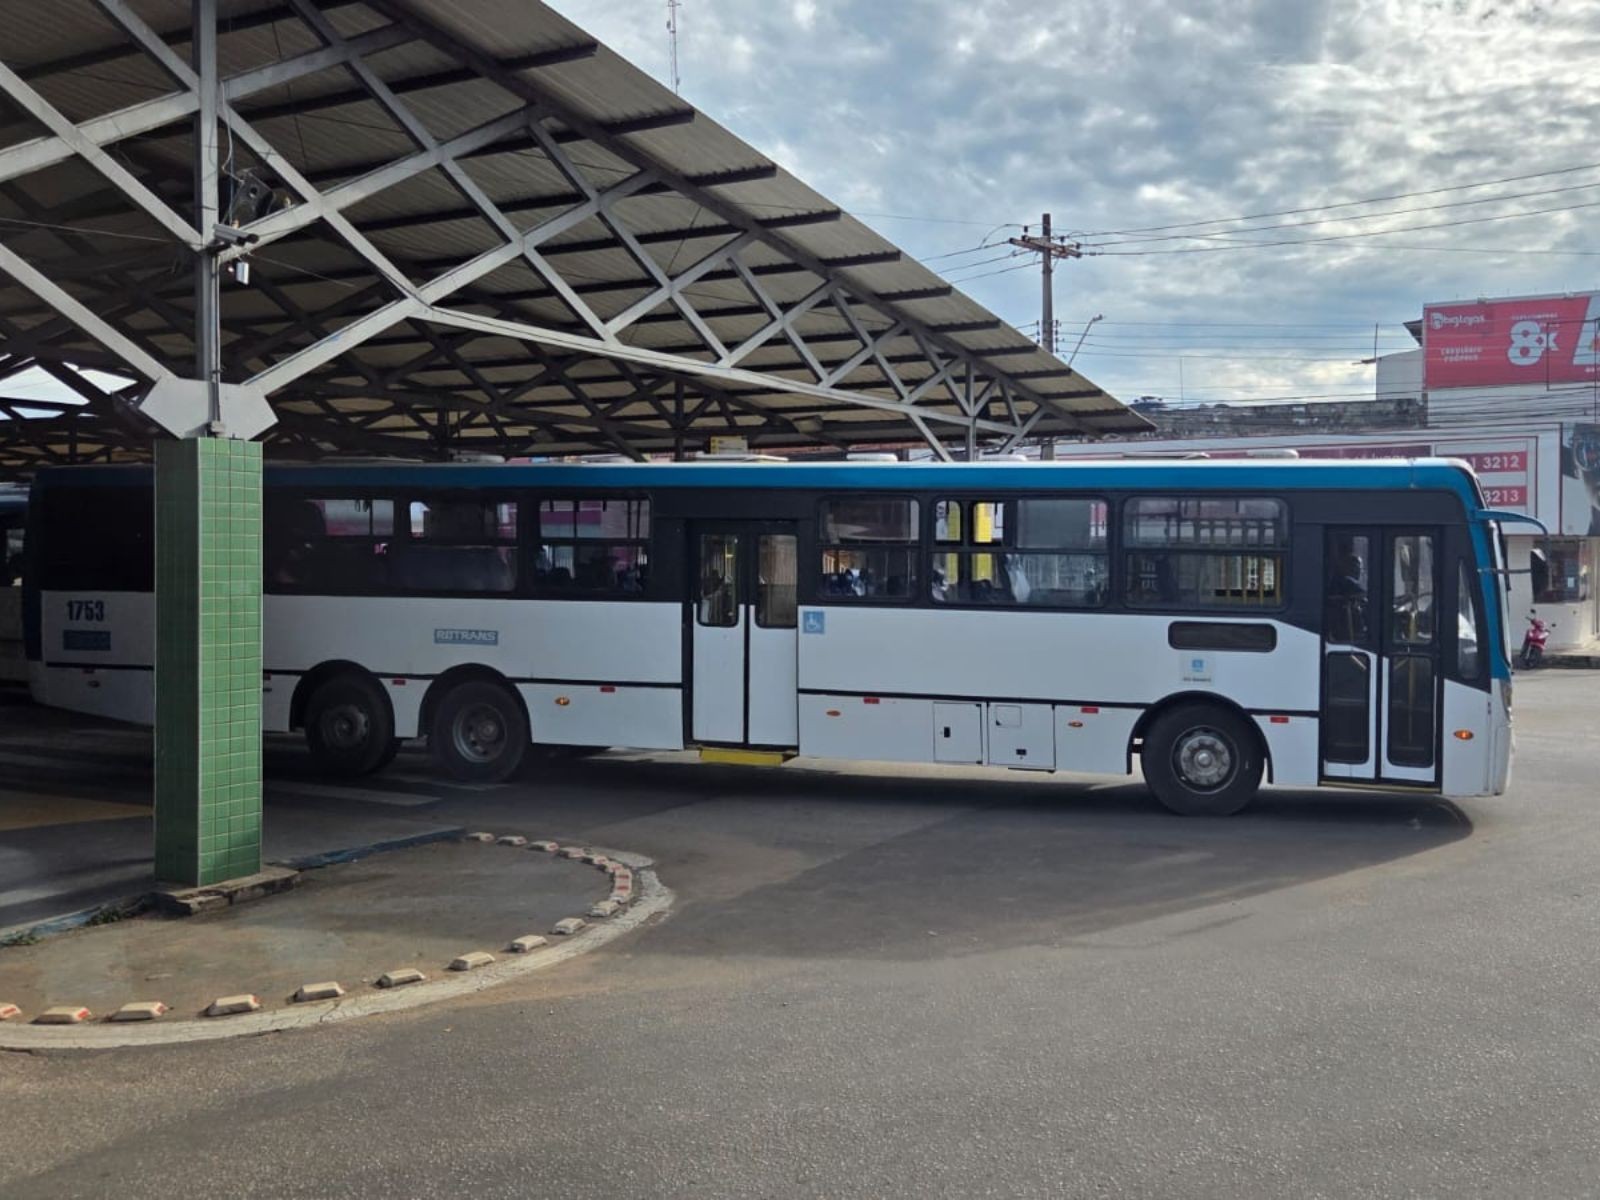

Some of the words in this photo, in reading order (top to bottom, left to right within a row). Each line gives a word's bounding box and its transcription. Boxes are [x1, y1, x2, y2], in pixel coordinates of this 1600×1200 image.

[1482, 455, 1520, 469] 3212
[1484, 490, 1520, 503] 3213
[66, 599, 105, 621] 1753
